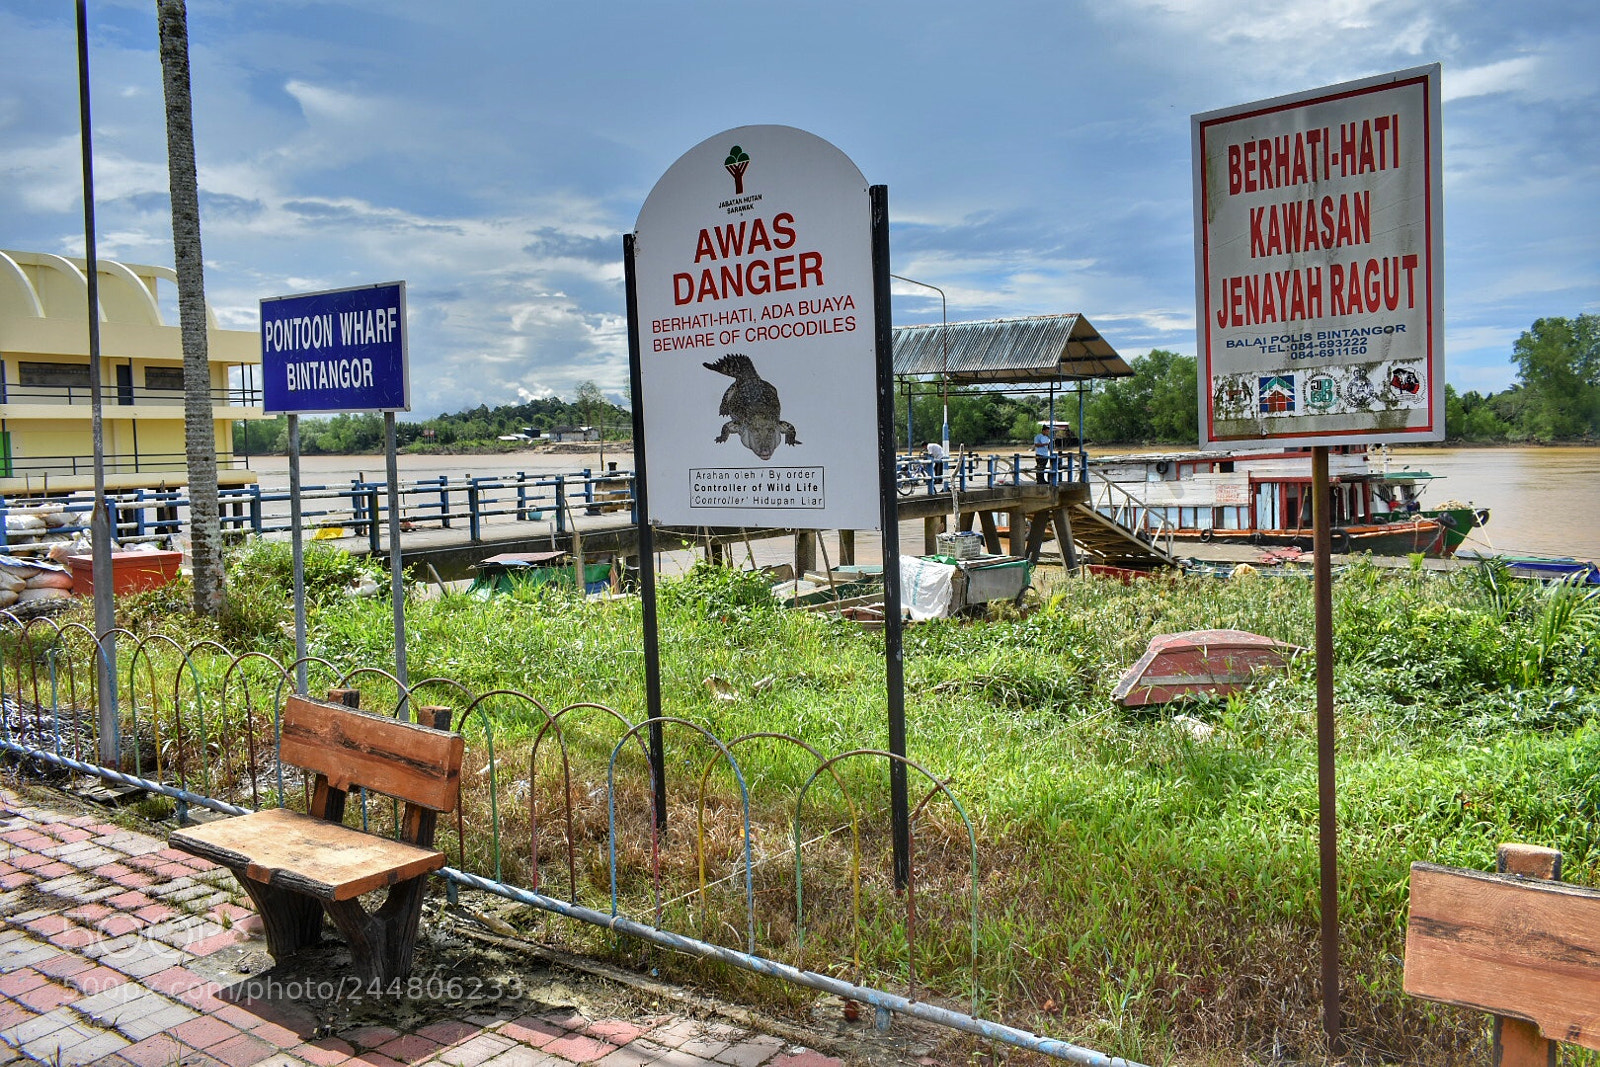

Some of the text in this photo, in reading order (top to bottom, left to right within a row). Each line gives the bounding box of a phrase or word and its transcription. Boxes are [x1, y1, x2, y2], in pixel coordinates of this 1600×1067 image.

[1228, 114, 1400, 196] BERHATI-HATI
[718, 193, 763, 209] JABATAN HUTAN
[727, 203, 755, 215] SARAWAK
[694, 212, 797, 264] AWAS
[1250, 190, 1371, 258] KAWASAN
[673, 251, 824, 306] DANGER
[1217, 254, 1418, 329] JENAYAH RAGUT
[265, 307, 397, 352] PONTOON WHARF
[652, 295, 855, 334] BERHATI-HATI, ADA BUAYA
[653, 316, 856, 352] BEWARE OF CROCODILES
[1226, 324, 1406, 348] BALAI POLIS BINTANGOR
[1290, 346, 1367, 361] 084-691150
[286, 358, 374, 391] BINTANGOR
[693, 482, 818, 492] Controller of Wild Life
[695, 470, 730, 480] Arahan
[734, 470, 756, 480] oleh
[769, 469, 781, 481] By
[786, 469, 815, 479] order
[753, 496, 795, 507] Hidupan
[801, 496, 822, 506] Liar
